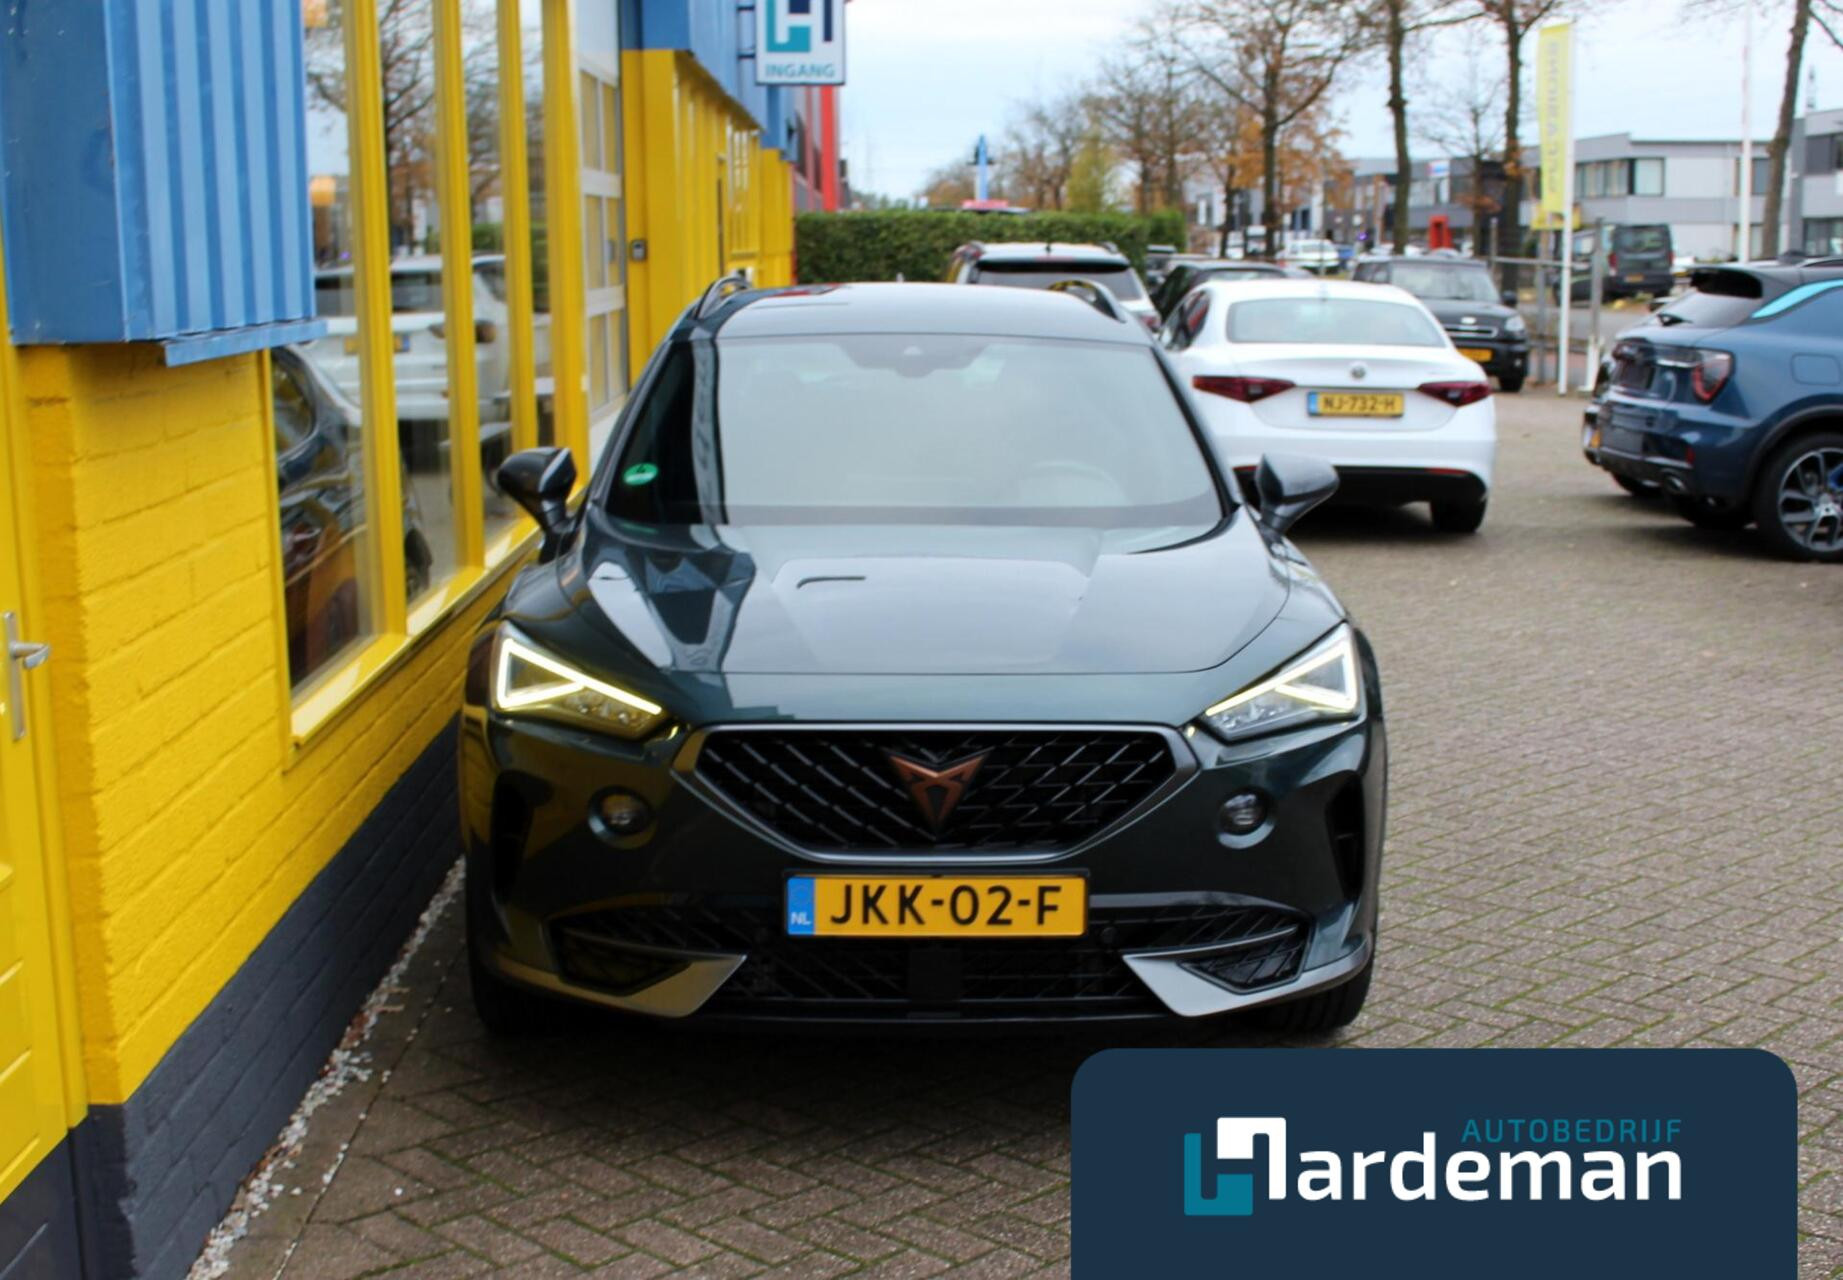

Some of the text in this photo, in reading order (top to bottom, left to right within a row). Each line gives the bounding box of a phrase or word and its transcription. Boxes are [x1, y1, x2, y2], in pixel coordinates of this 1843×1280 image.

[765, 64, 835, 78] INGANG
[1322, 395, 1396, 411] NJ-732-H
[790, 884, 1062, 926] NL JKK-02-F
